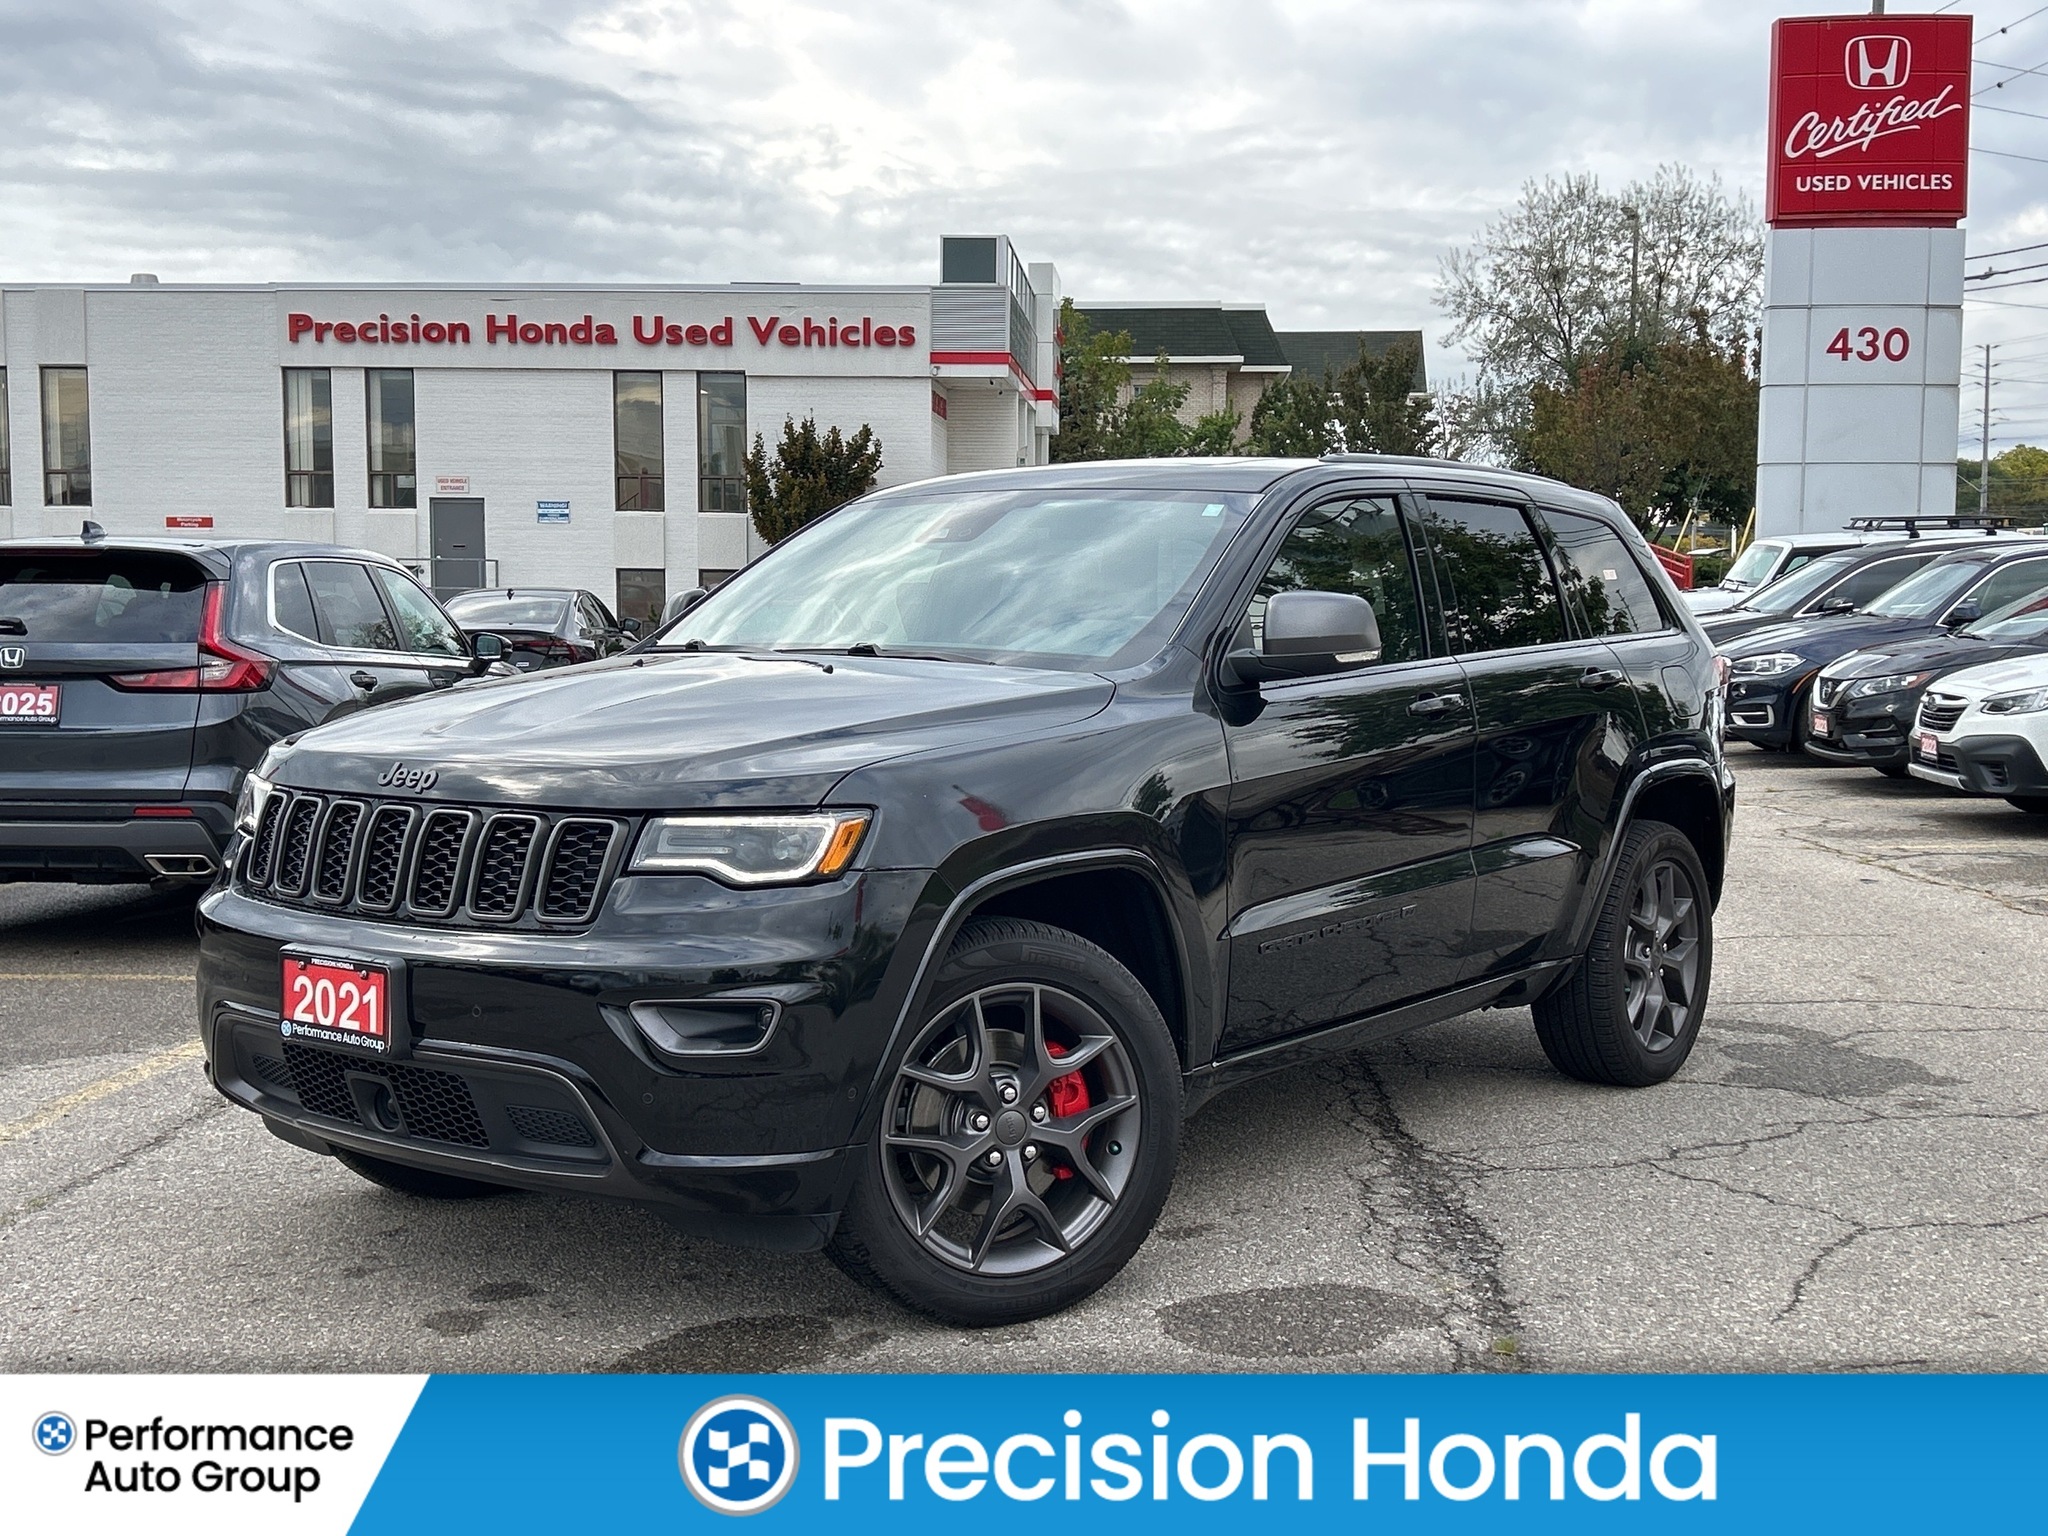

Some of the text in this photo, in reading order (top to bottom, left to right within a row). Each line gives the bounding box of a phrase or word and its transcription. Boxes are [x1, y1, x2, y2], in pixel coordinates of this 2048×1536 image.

[1785, 85, 1963, 159] Certified
[1796, 174, 1953, 192] USED VEHICLES
[288, 313, 915, 347] Precision Honda Used Vehicles
[1826, 327, 1910, 362] 430
[0, 692, 53, 716] 025
[377, 761, 439, 795] Jeep
[292, 974, 378, 1035] 2021
[292, 1023, 385, 1053] Performance Auto Group
